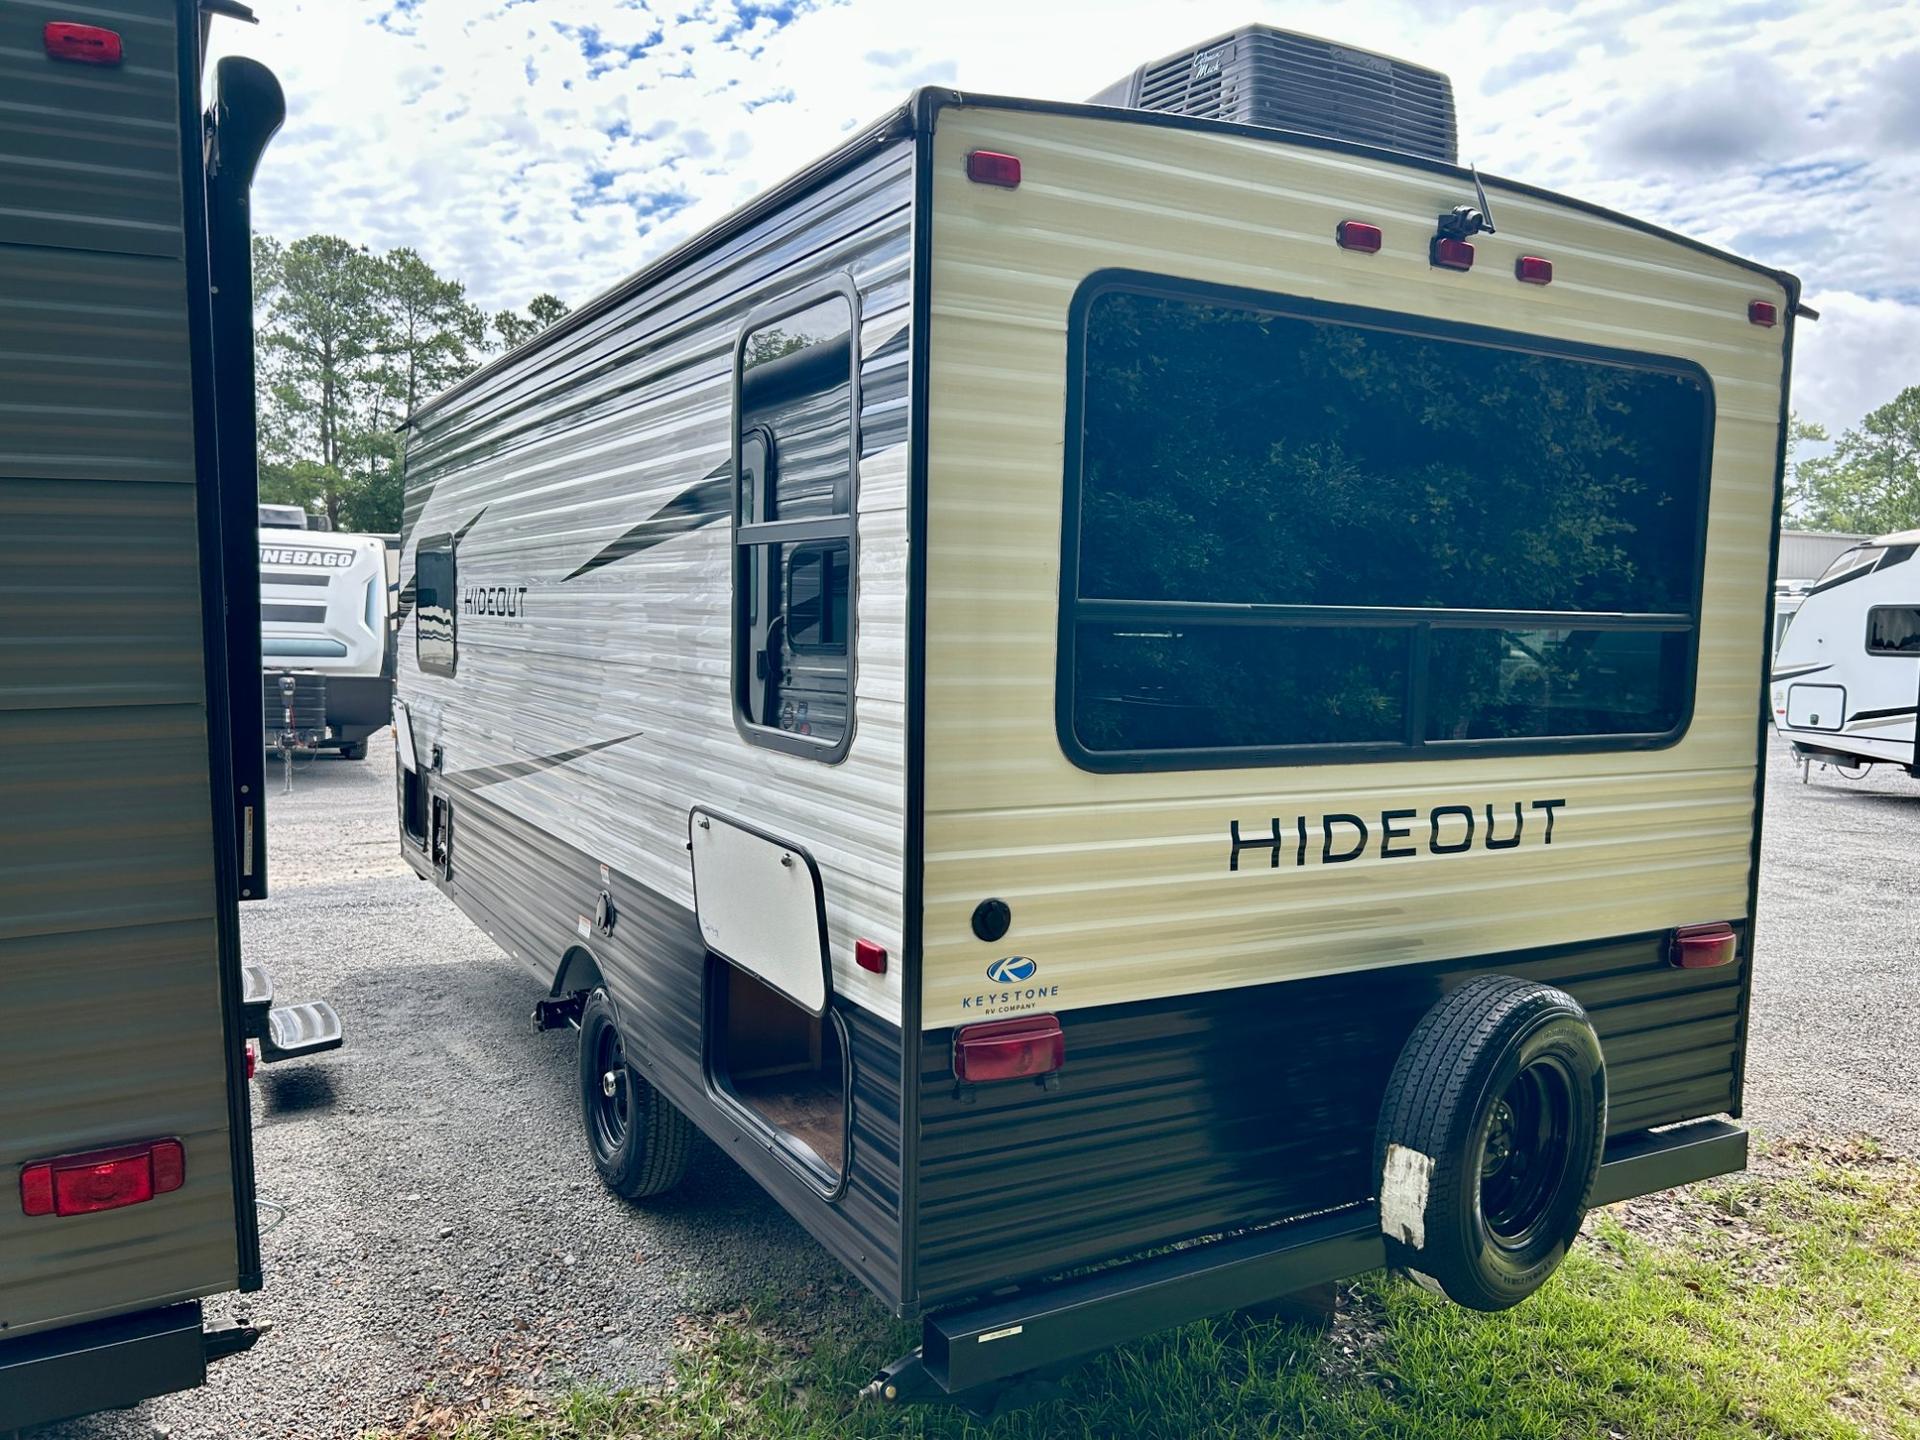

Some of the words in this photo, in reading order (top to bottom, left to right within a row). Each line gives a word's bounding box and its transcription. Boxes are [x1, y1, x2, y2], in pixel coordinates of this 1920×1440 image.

[259, 549, 352, 567] NEBAGO
[464, 587, 527, 617] HIDEOUT
[1230, 799, 1566, 871] HIDEOUT
[962, 986, 1059, 1008] KEYSTONE
[998, 1002, 1036, 1013] COMPANY
